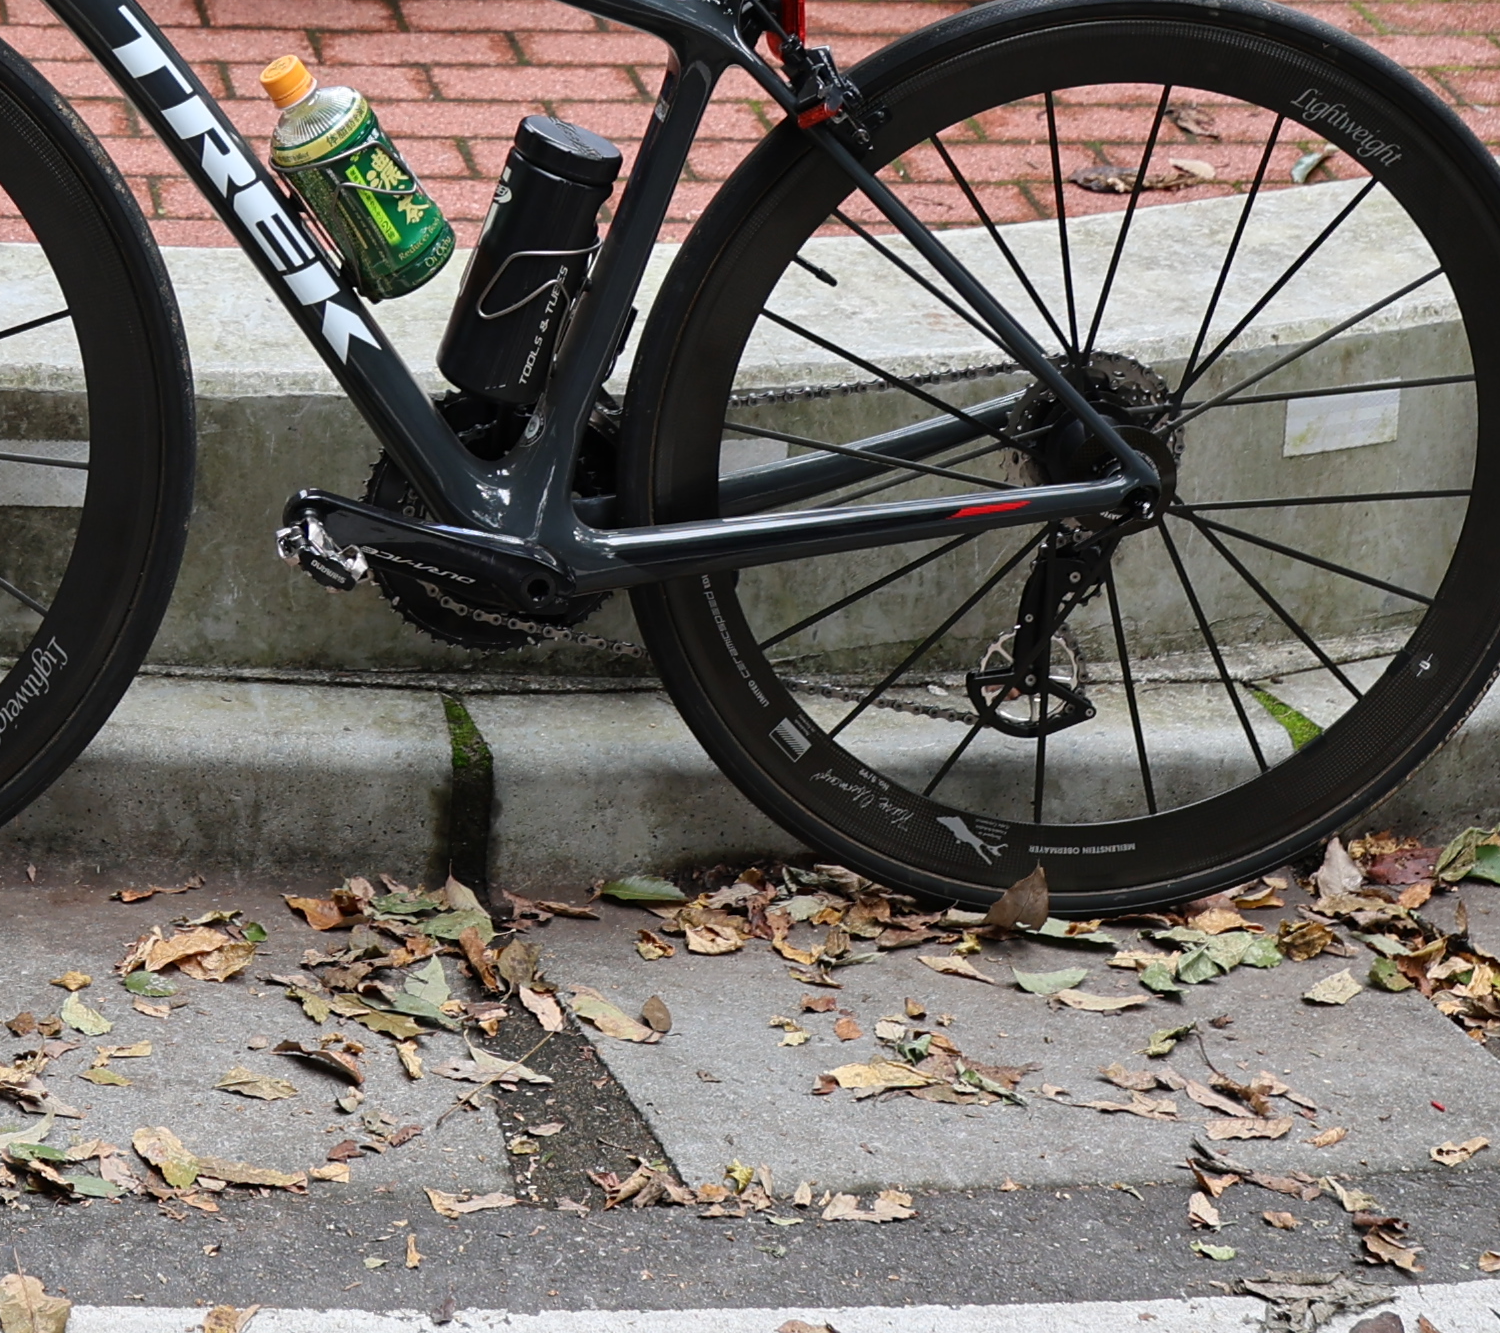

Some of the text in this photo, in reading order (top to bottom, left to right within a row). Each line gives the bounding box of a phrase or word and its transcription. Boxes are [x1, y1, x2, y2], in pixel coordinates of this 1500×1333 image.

[1289, 87, 1403, 168] Lightweight
[111, 4, 384, 366] TREK
[518, 264, 570, 385] TOOLS & TUBES
[360, 544, 476, 586] DURA-ACE
[702, 590, 770, 709] LIMITED ceramicspeed
[1028, 842, 1136, 855] MEILENSTEIN OBERMAYER
